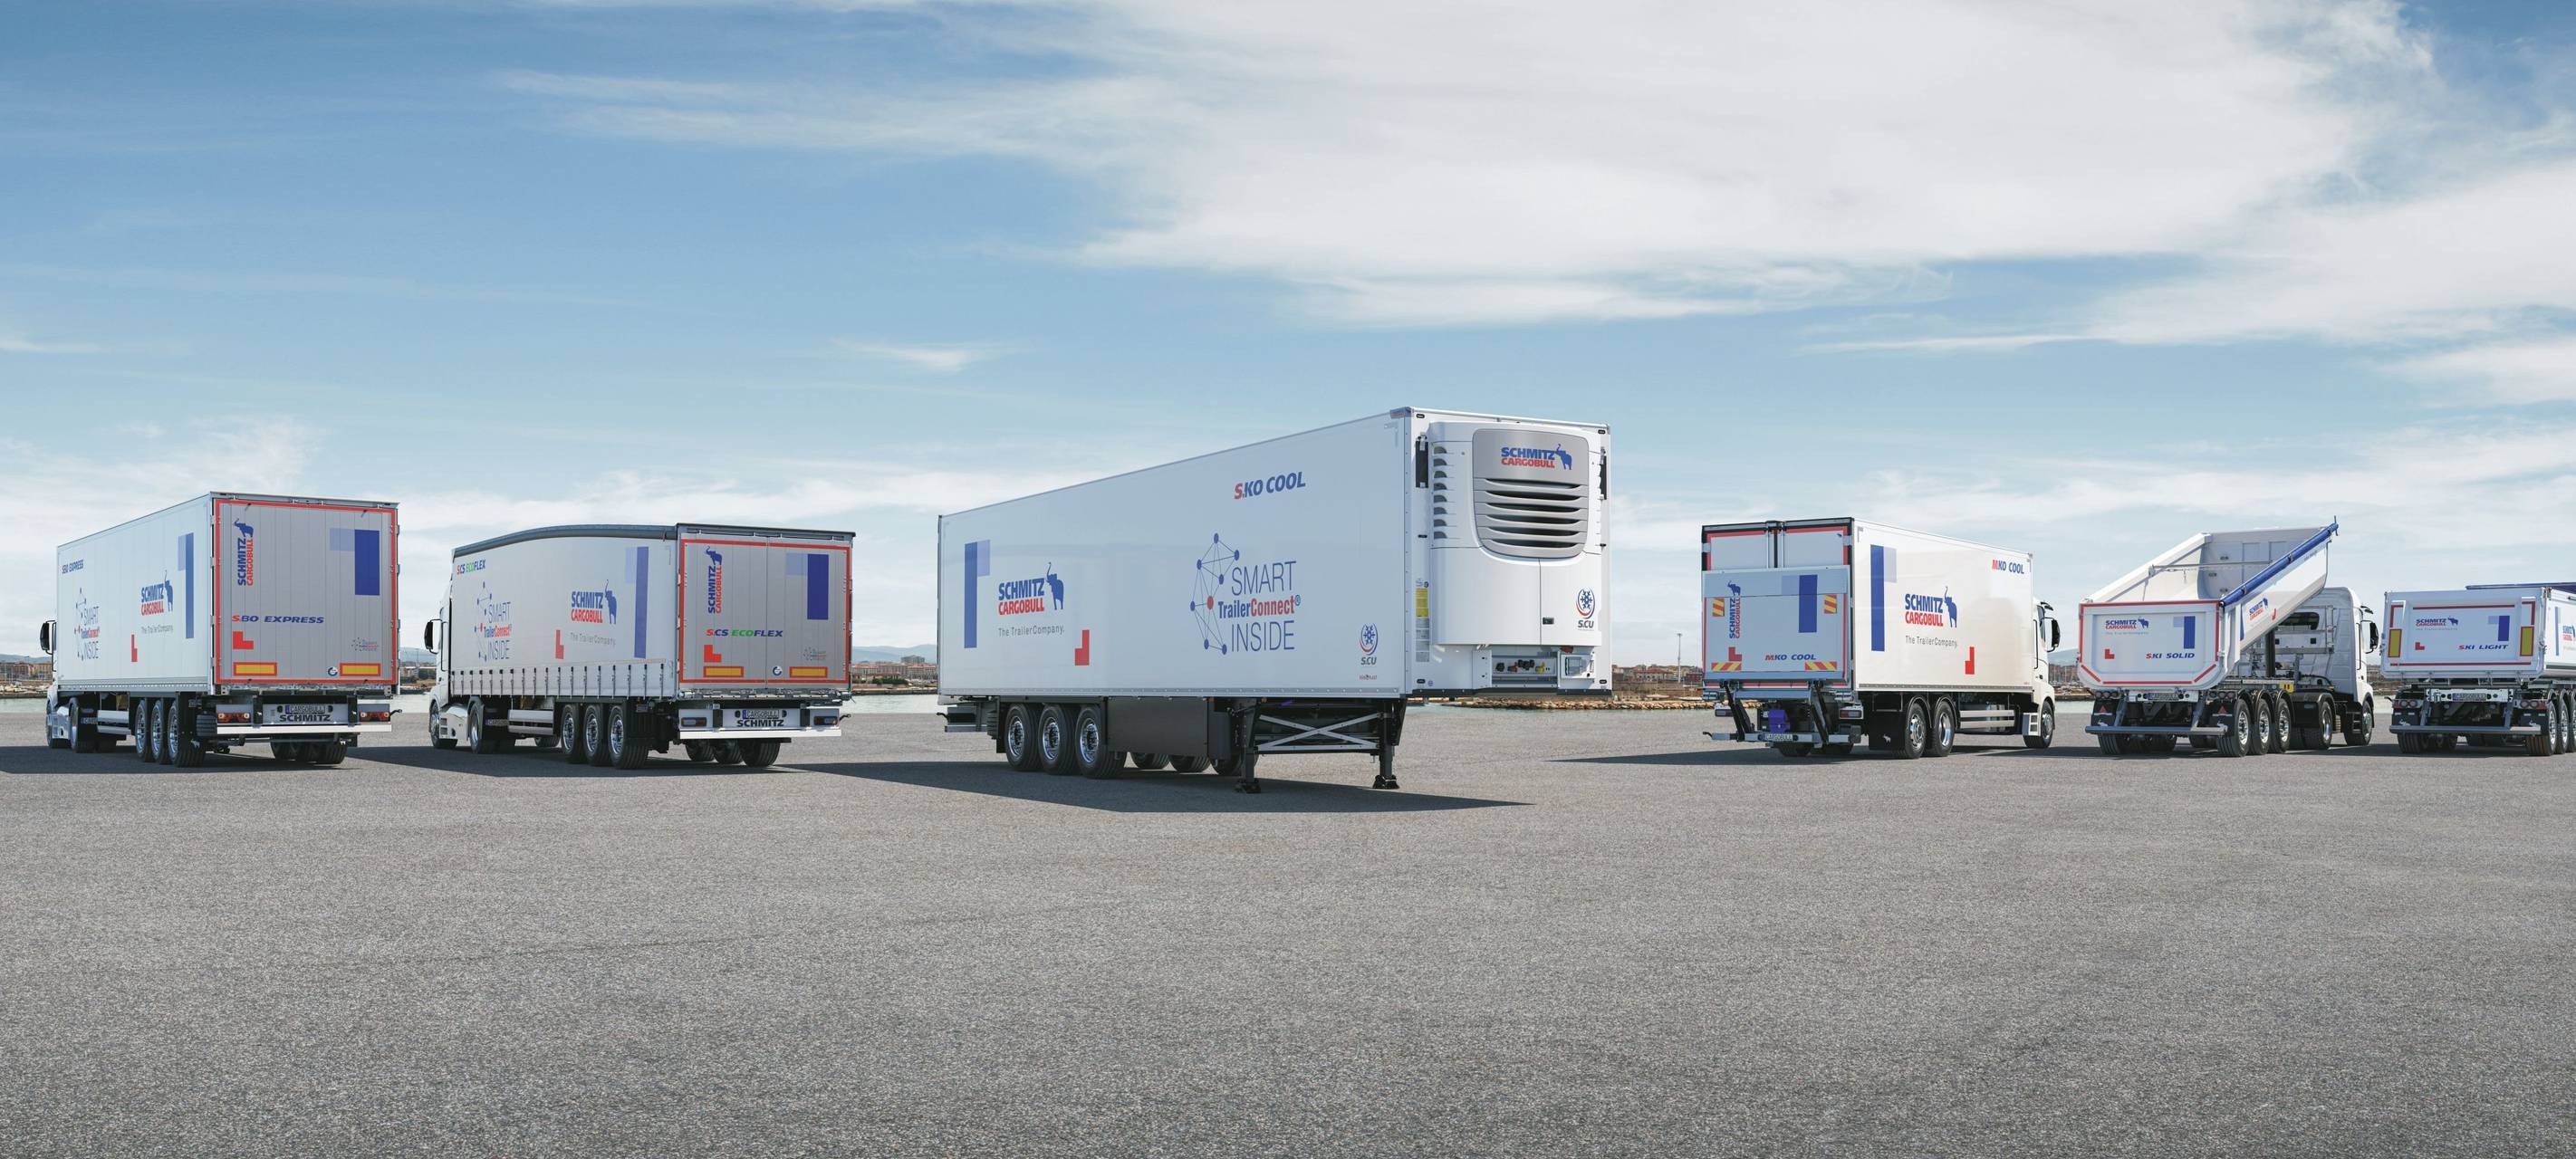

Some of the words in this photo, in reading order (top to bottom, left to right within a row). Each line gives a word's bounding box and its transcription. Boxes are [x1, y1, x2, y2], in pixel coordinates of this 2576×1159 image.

[1501, 447, 1555, 460] SCHMITZ
[1501, 458, 1555, 468] CARGOBULL
[1234, 480, 1264, 499] S.KO
[1265, 471, 1306, 493] COOL
[237, 537, 246, 586] SCHMITZ
[2008, 561, 2025, 574] COOL
[1231, 560, 1297, 596] SMART
[140, 582, 164, 603] SCHMITZ
[708, 565, 716, 614] SCHMITZ
[998, 577, 1045, 601] SCHMITZ
[571, 590, 604, 609] SCHMITZ
[998, 597, 1044, 616] CARGOBULL
[1905, 593, 1944, 614] SCHMITZ
[140, 600, 165, 617] CARGOBULL
[488, 601, 511, 624] SMART
[571, 608, 603, 624] CARGOBULL
[264, 616, 324, 624] EXPRESS
[1905, 610, 1944, 627] CARGOBULL
[730, 629, 783, 637] ECOFLEX
[998, 627, 1010, 637] The
[1231, 619, 1295, 652] INSIDE
[1905, 635, 1916, 645] The
[487, 639, 510, 660] INSIDE
[290, 705, 324, 714] CARGOBULL
[279, 714, 332, 723] SCHMITZ
[736, 719, 784, 727] SCHMITZ
